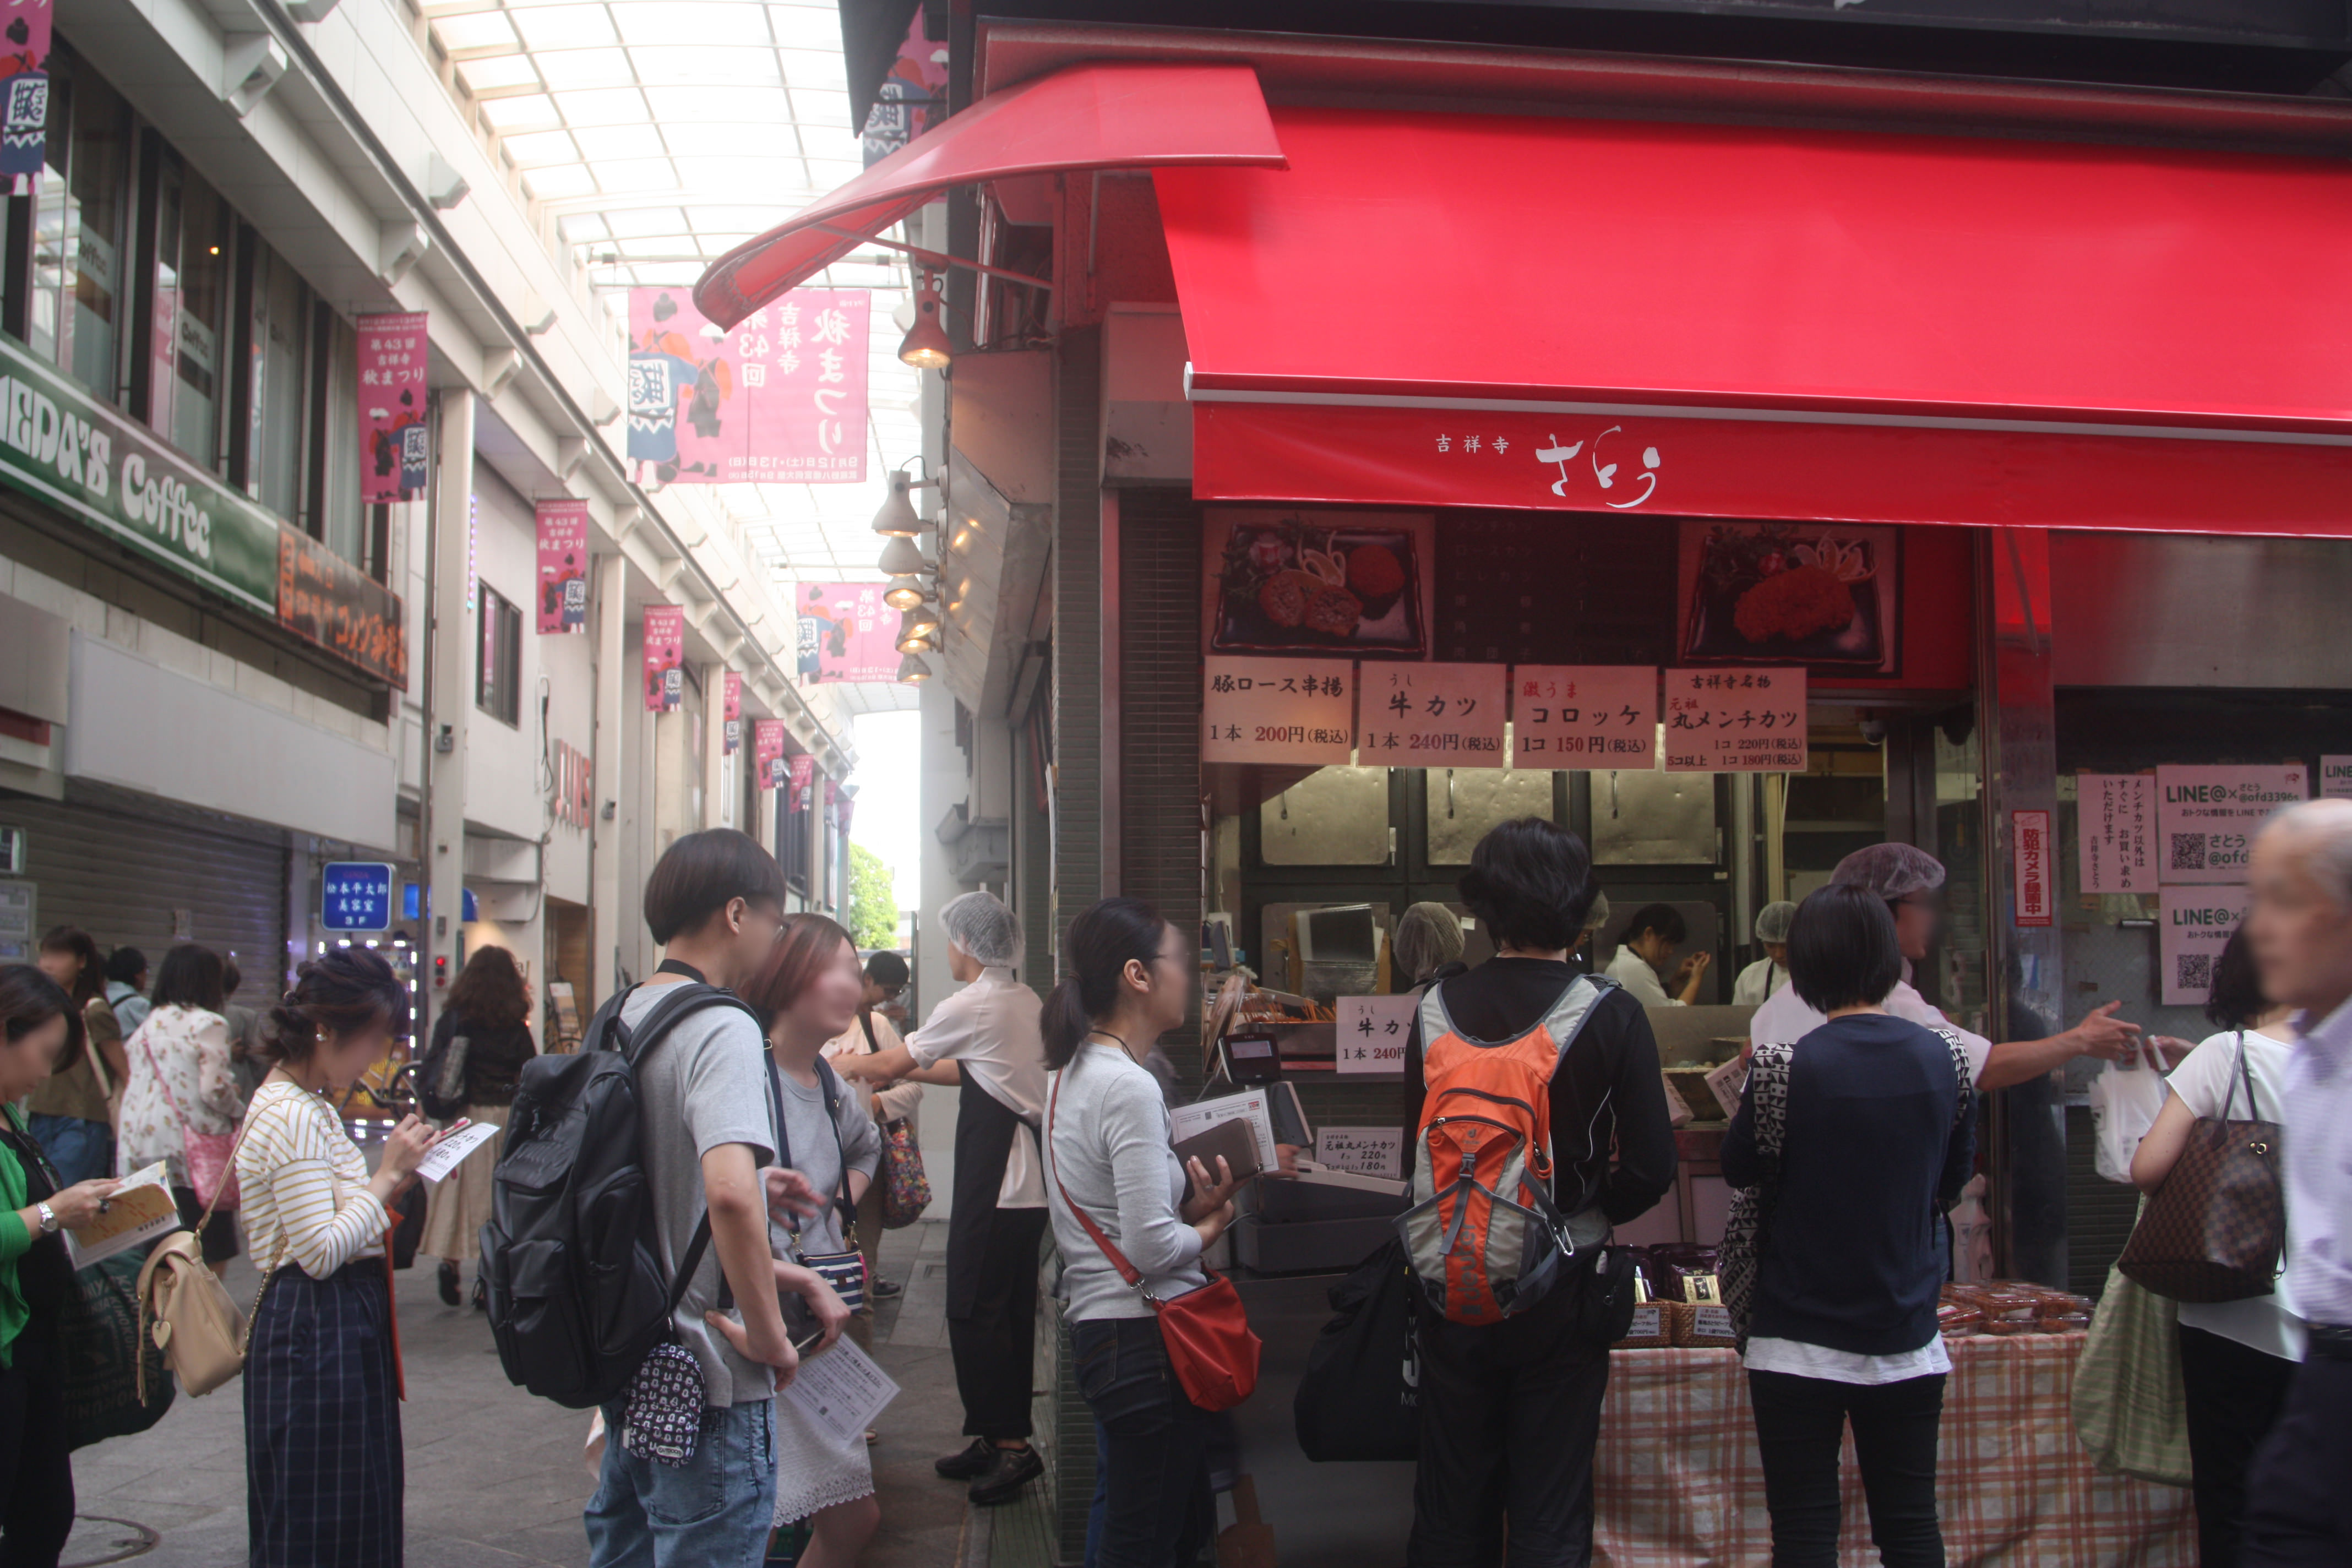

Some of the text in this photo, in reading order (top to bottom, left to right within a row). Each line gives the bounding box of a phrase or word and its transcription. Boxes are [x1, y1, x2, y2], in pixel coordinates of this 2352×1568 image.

[362, 367, 424, 385] 秋まつり
[1435, 433, 1509, 454] 吉祥寺
[122, 452, 210, 559] Coffee
[1212, 674, 1343, 698] 豚ロース串揚
[1389, 673, 1412, 688] うし
[1523, 681, 1577, 699] 激うま
[1691, 674, 1771, 689] 吉祥寺名物
[1389, 690, 1476, 719] 牛カツ
[1669, 697, 1698, 711] 元祖
[1532, 705, 1641, 727] コロッケ
[1670, 710, 1797, 729] 丸メンチカツ
[2103, 779, 2114, 846] いただけます
[2181, 809, 2234, 817] おトクな情報を
[2133, 779, 2145, 867] メンチカツ以外は
[2119, 778, 2131, 888] すぐに お買い求め
[2209, 834, 2246, 848] さとう
[2023, 828, 2041, 915] 防犯カメラ録画中
[337, 898, 374, 912] 美容室
[1358, 1005, 1374, 1014] うし
[1358, 1017, 1411, 1038] 牛カ
[1325, 1141, 1395, 1151] 元祖丸メンチカツ
